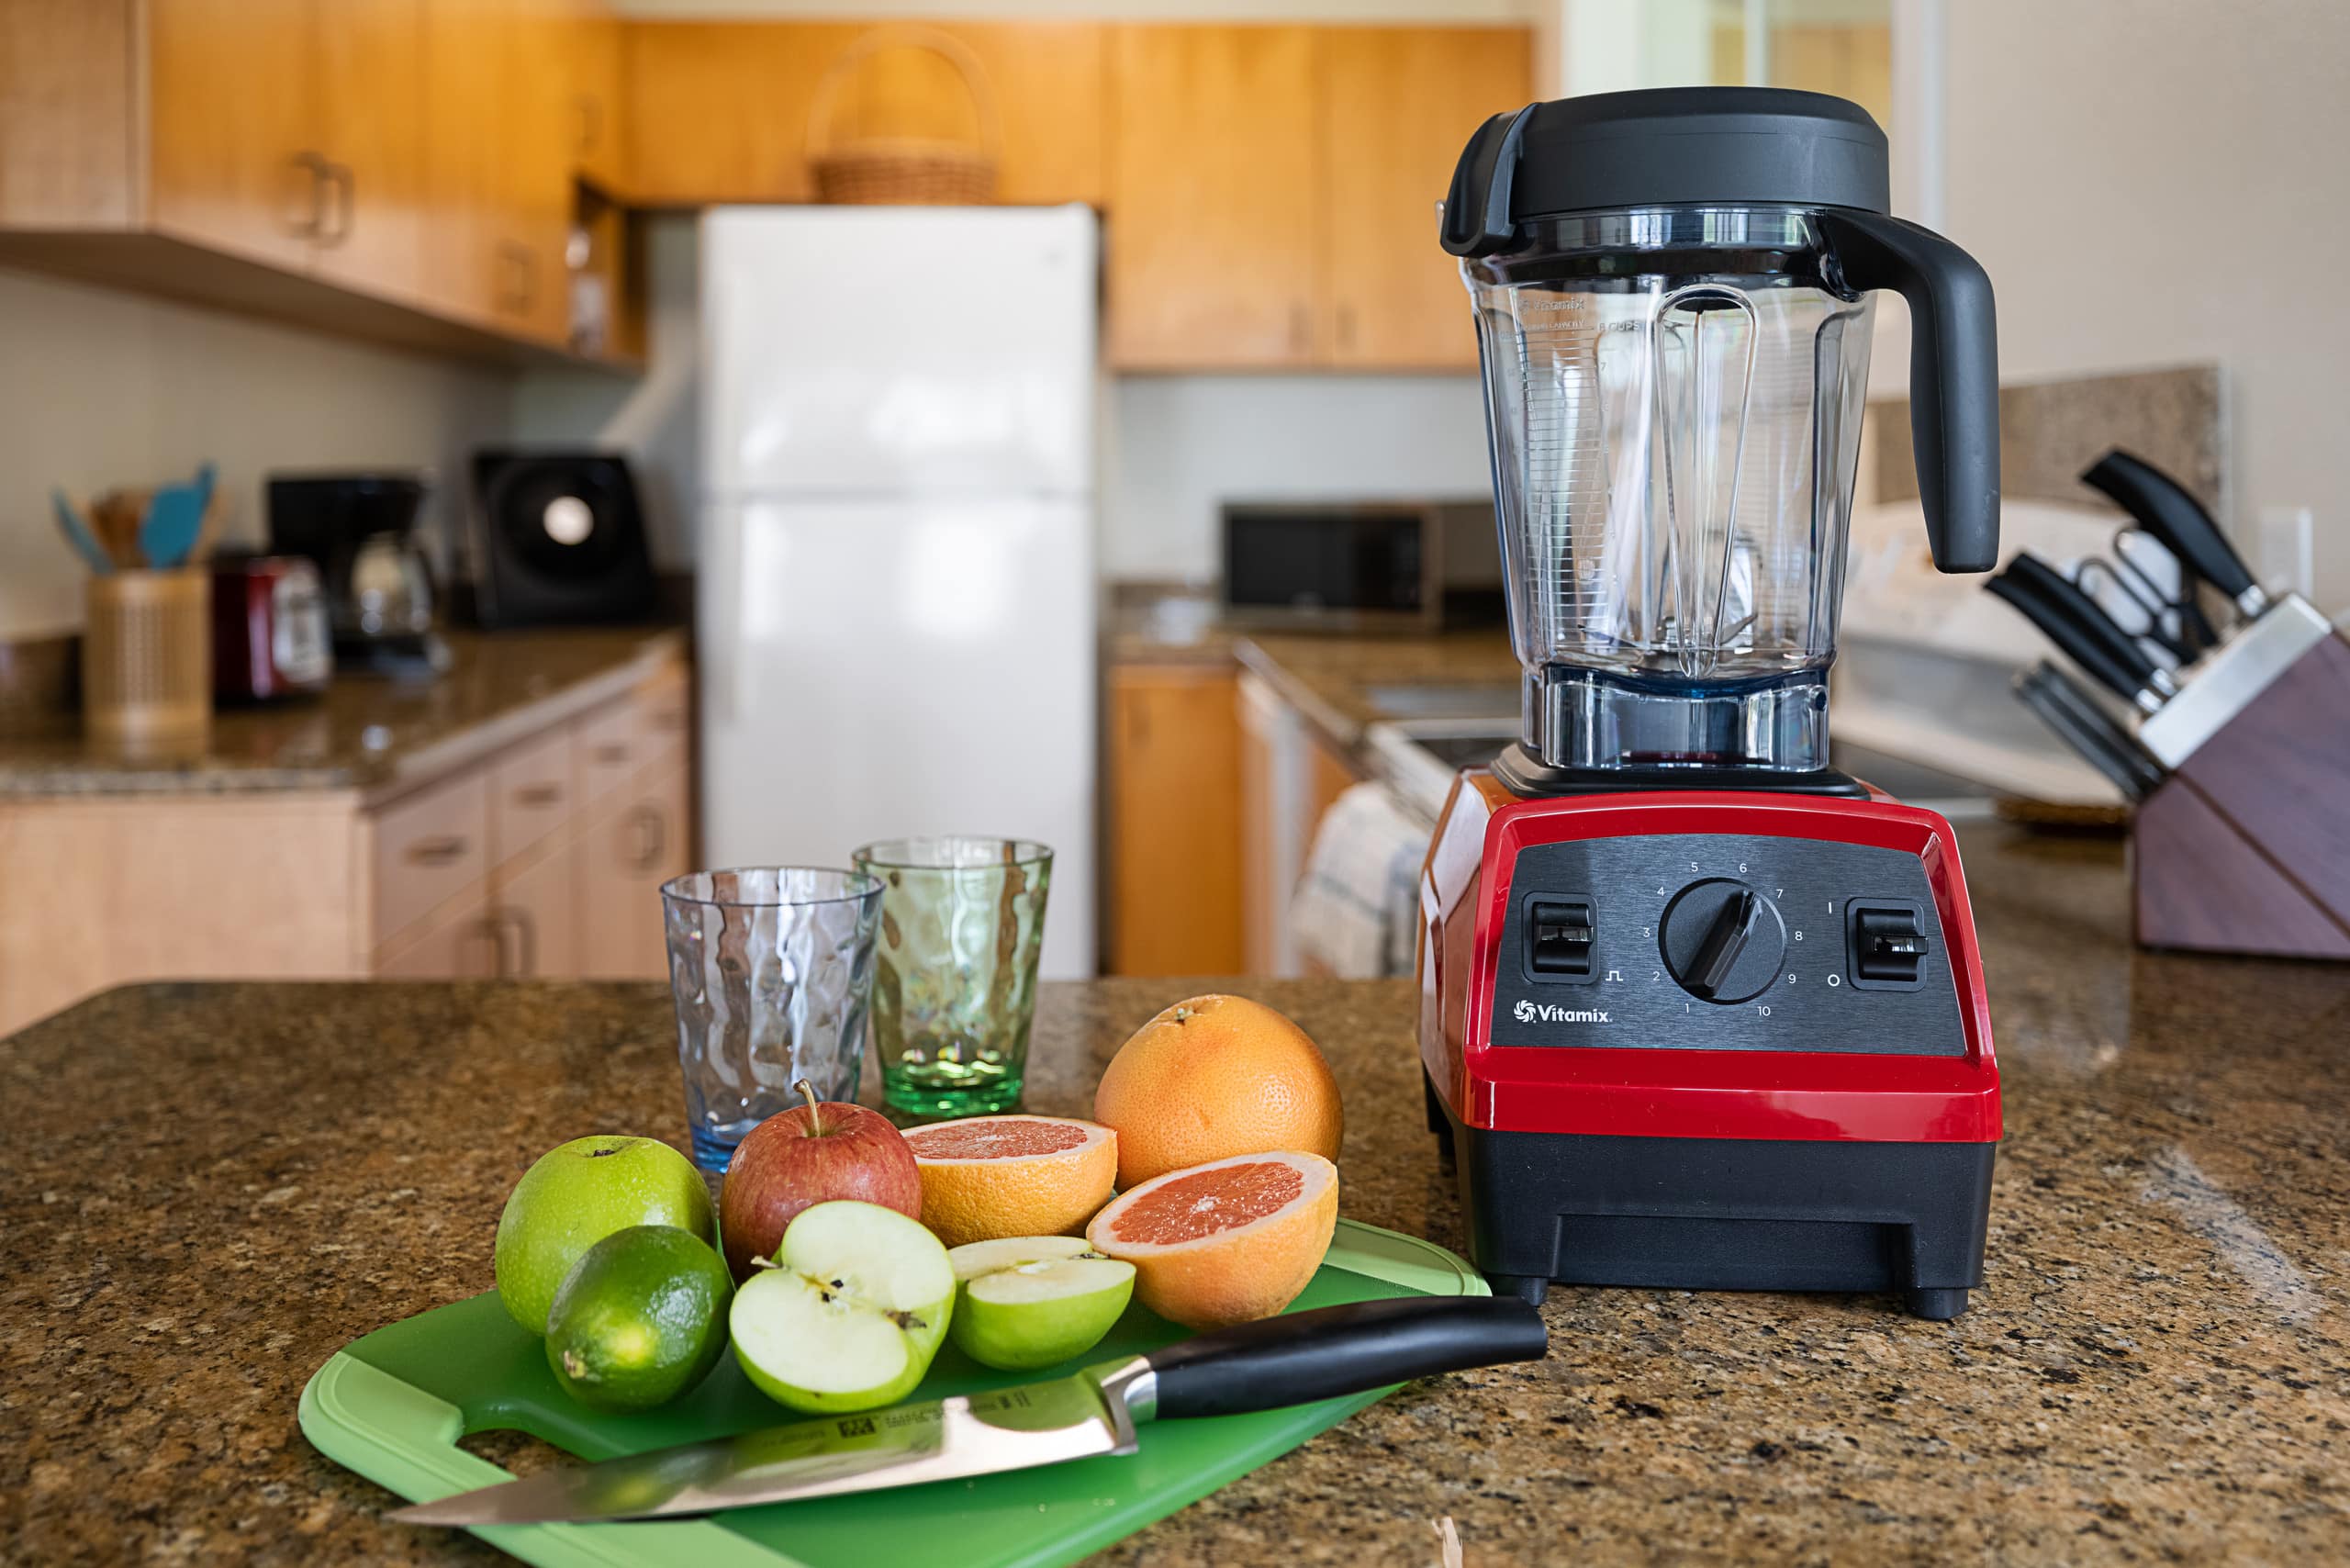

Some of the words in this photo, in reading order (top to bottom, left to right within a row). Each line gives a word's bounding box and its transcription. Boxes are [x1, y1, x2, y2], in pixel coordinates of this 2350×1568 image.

[1608, 321, 1639, 331] CUPS
[1691, 862, 1698, 872] 5
[1740, 863, 1747, 873] 6
[1657, 887, 1665, 897] 4
[1776, 889, 1784, 899] 7
[1643, 927, 1651, 937] 3
[1795, 931, 1803, 941] 8
[1653, 971, 1661, 981] 2
[1788, 974, 1796, 983] 9
[1537, 1004, 1609, 1023] Vitamix
[1684, 1003, 1690, 1014] 1
[1757, 1006, 1771, 1016] 10
